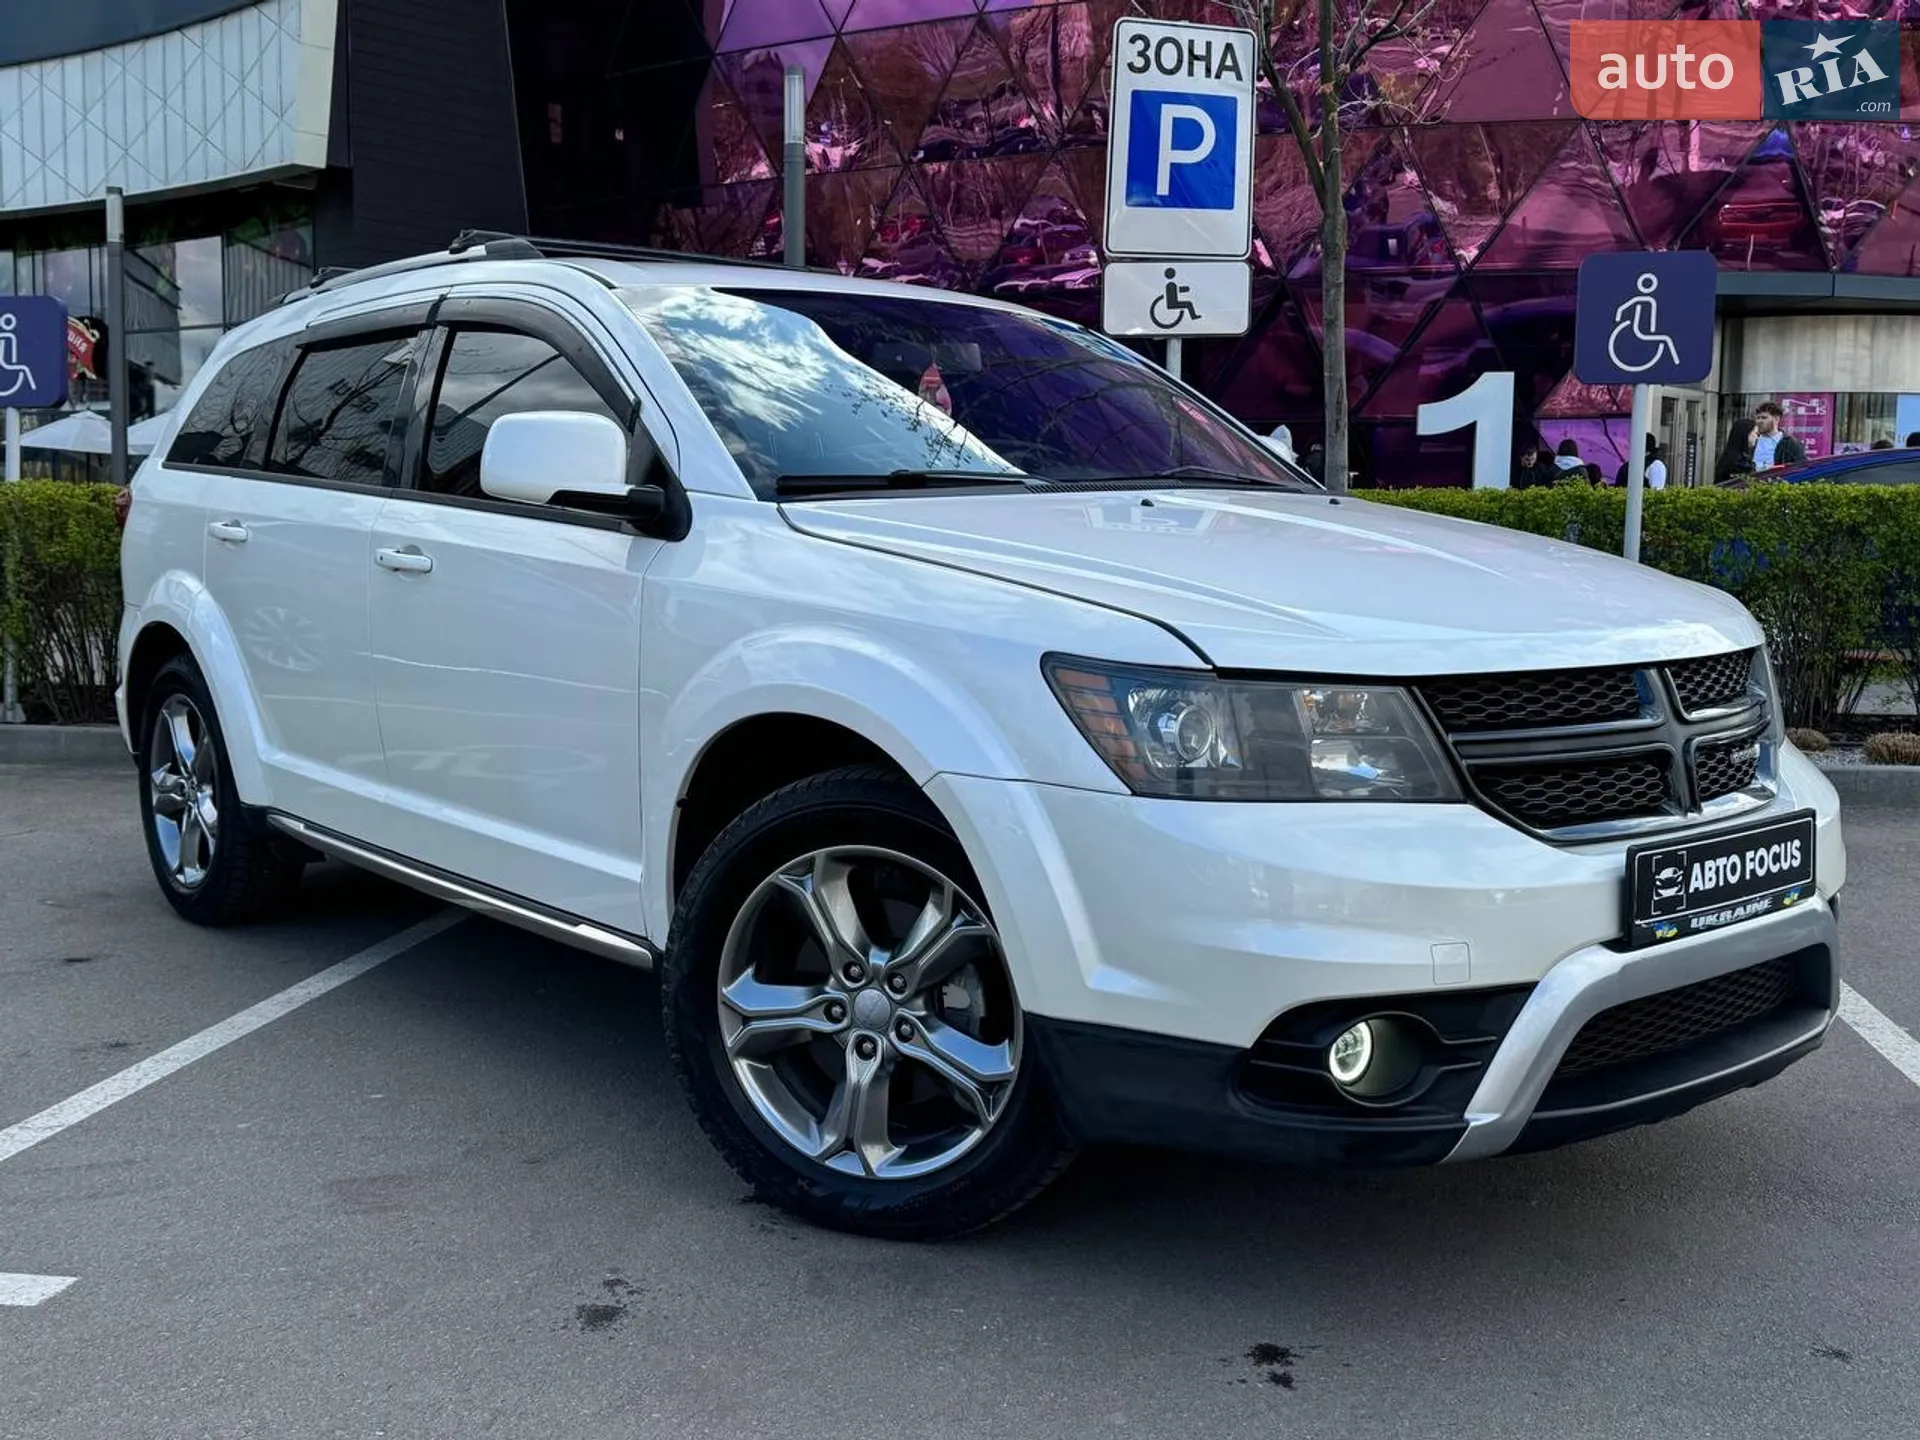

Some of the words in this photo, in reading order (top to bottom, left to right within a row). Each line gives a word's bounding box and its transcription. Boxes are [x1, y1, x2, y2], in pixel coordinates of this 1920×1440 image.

[1126, 33, 1244, 82] ЗОНА
[1155, 102, 1217, 197] P
[1416, 371, 1515, 490] 1
[1744, 838, 1802, 881] FOCUS
